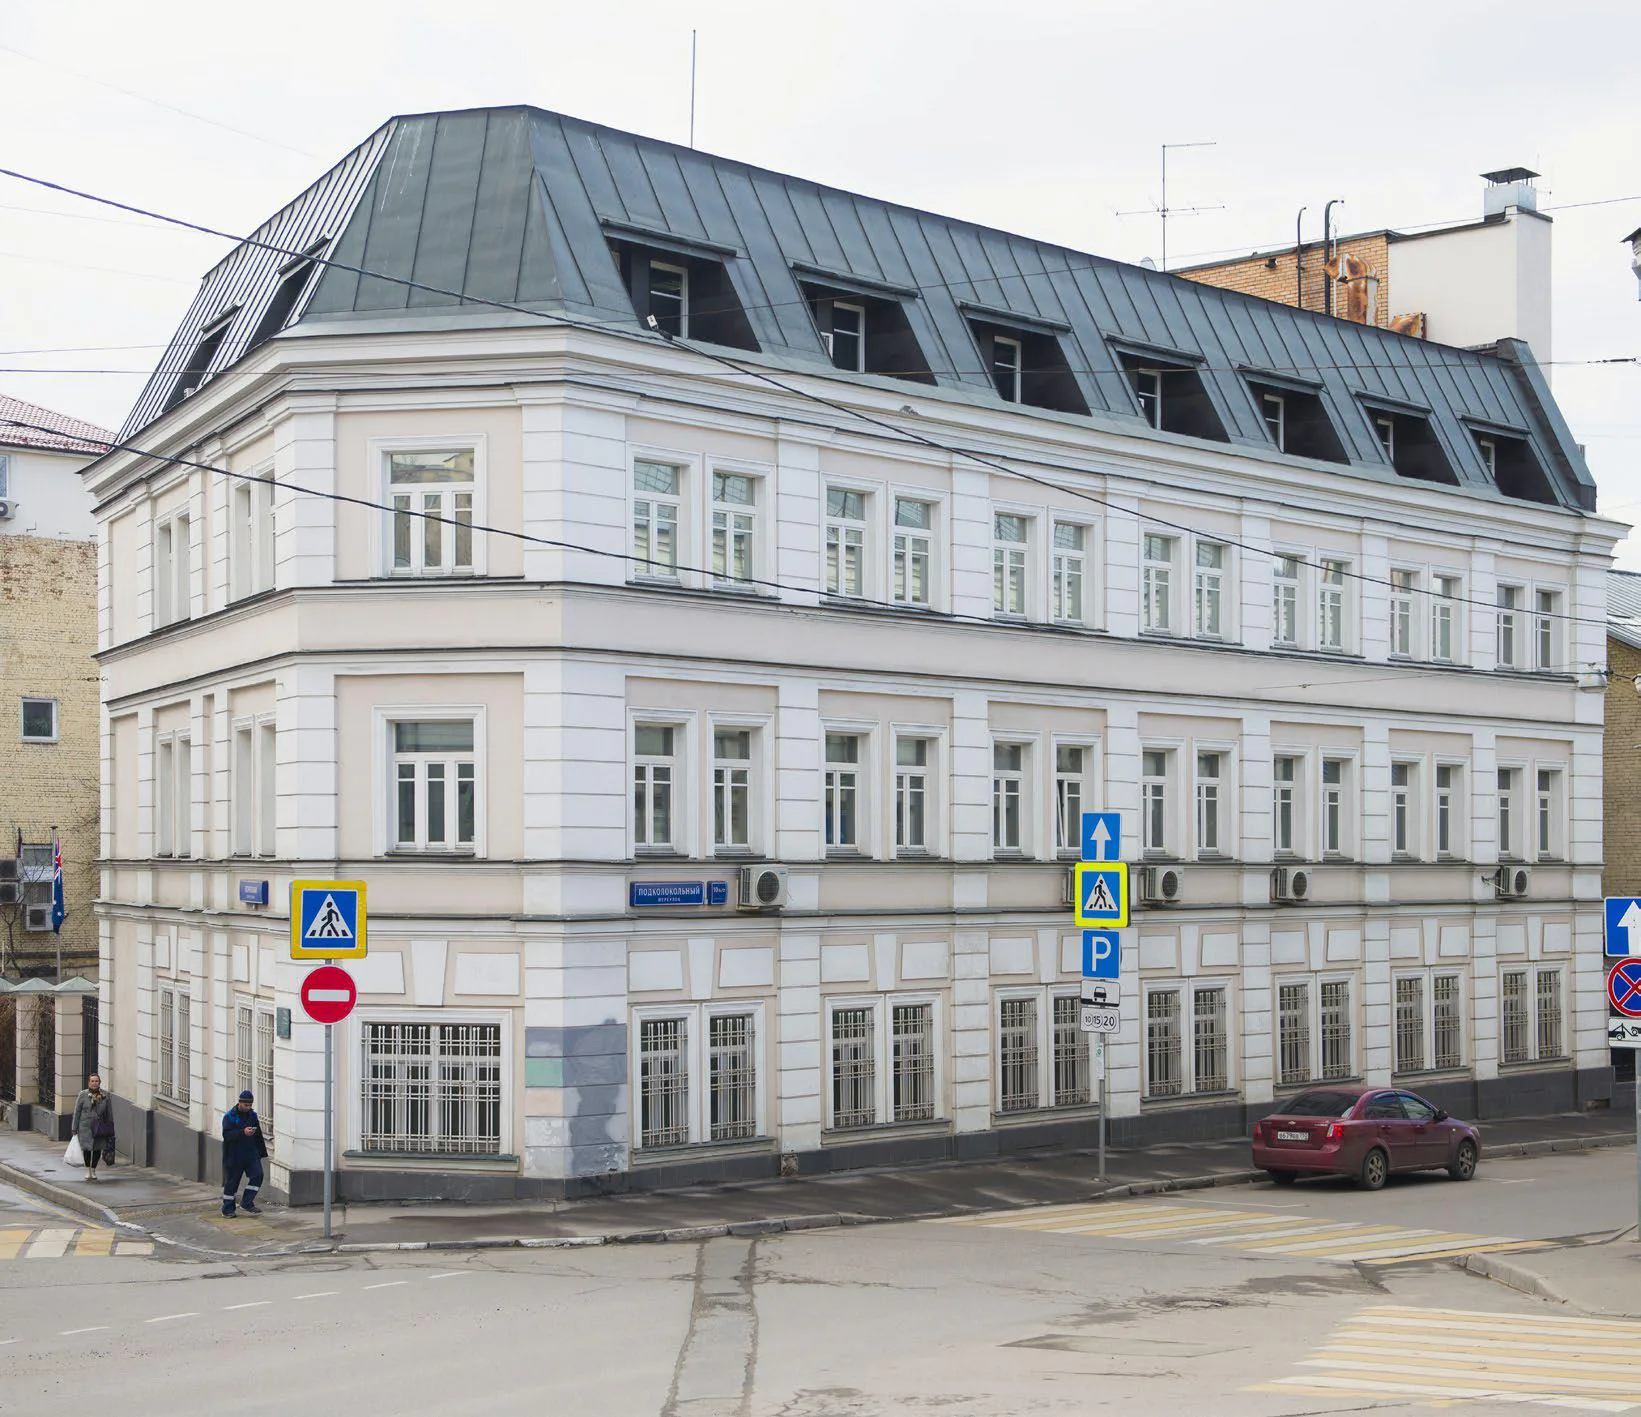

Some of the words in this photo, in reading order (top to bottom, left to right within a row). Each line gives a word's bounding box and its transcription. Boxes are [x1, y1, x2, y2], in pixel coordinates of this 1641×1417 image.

[638, 886, 700, 896] ПОДКОЛОКОЛЬНЫЙ
[1091, 936, 1112, 972] P
[1093, 1016, 1101, 1025] 15
[1103, 1016, 1115, 1027] 20
